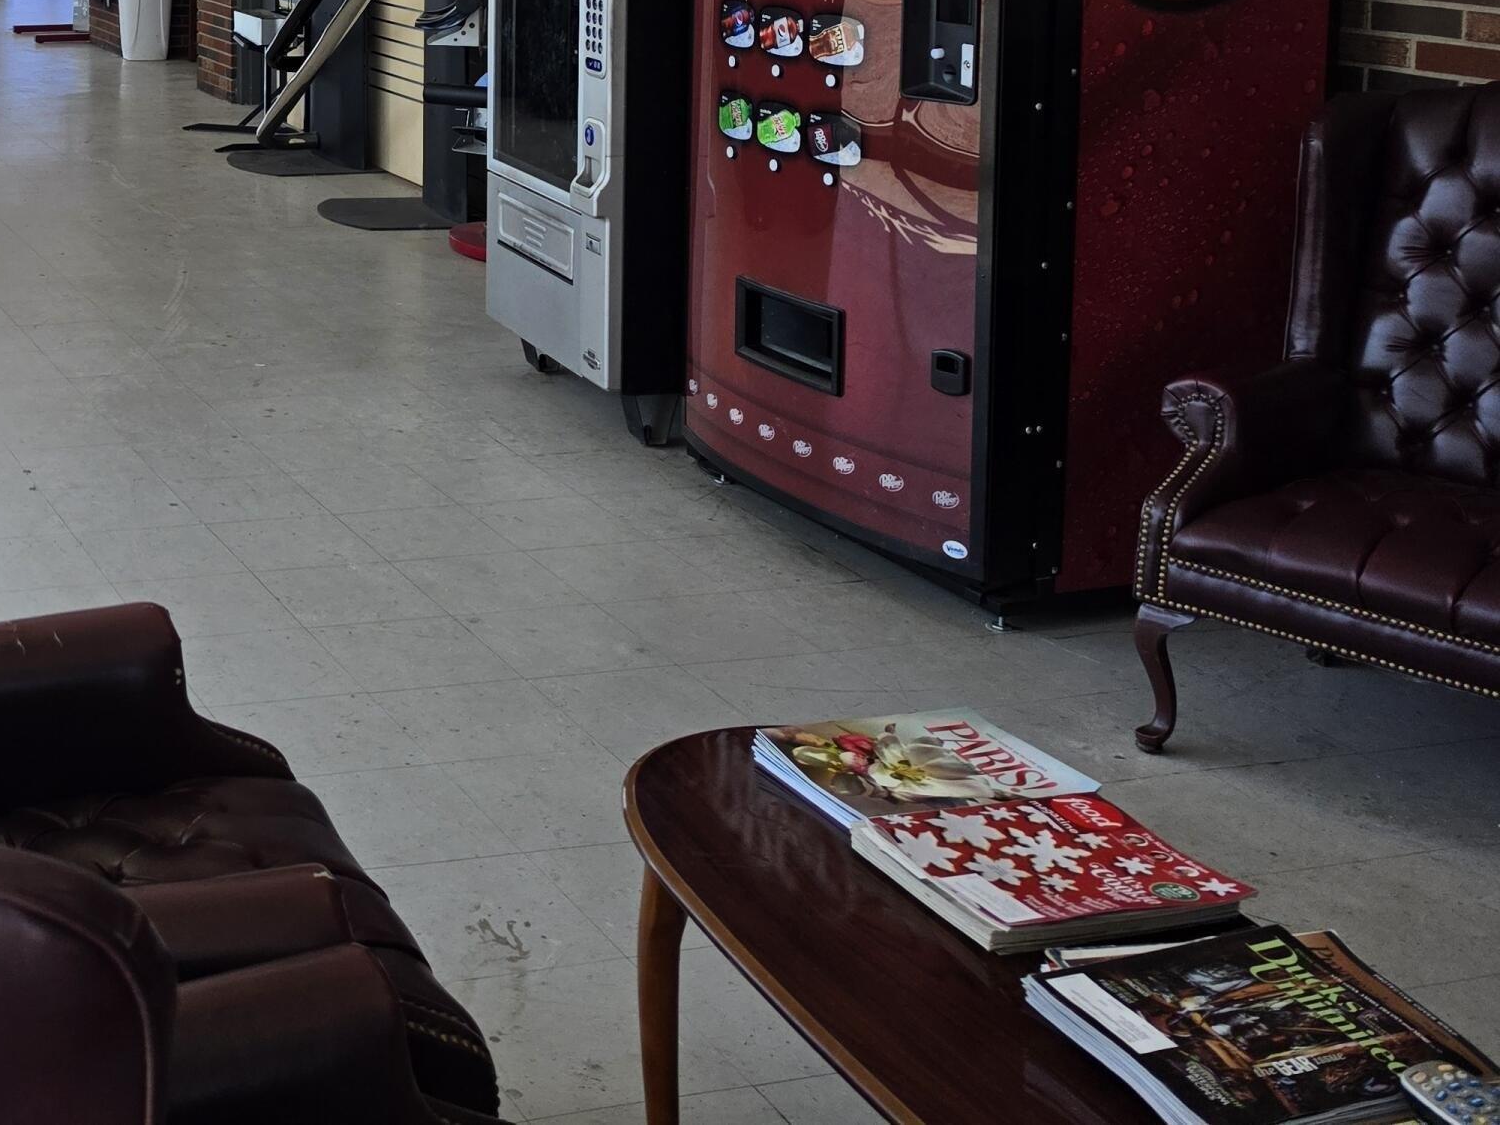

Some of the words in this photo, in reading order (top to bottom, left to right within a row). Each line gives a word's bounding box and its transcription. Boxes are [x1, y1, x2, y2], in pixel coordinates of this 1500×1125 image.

[924, 722, 1058, 793] PARIS!
[1052, 797, 1122, 827] food
[1245, 936, 1364, 1013] Ducks
[1272, 1055, 1319, 1077] GEAR
